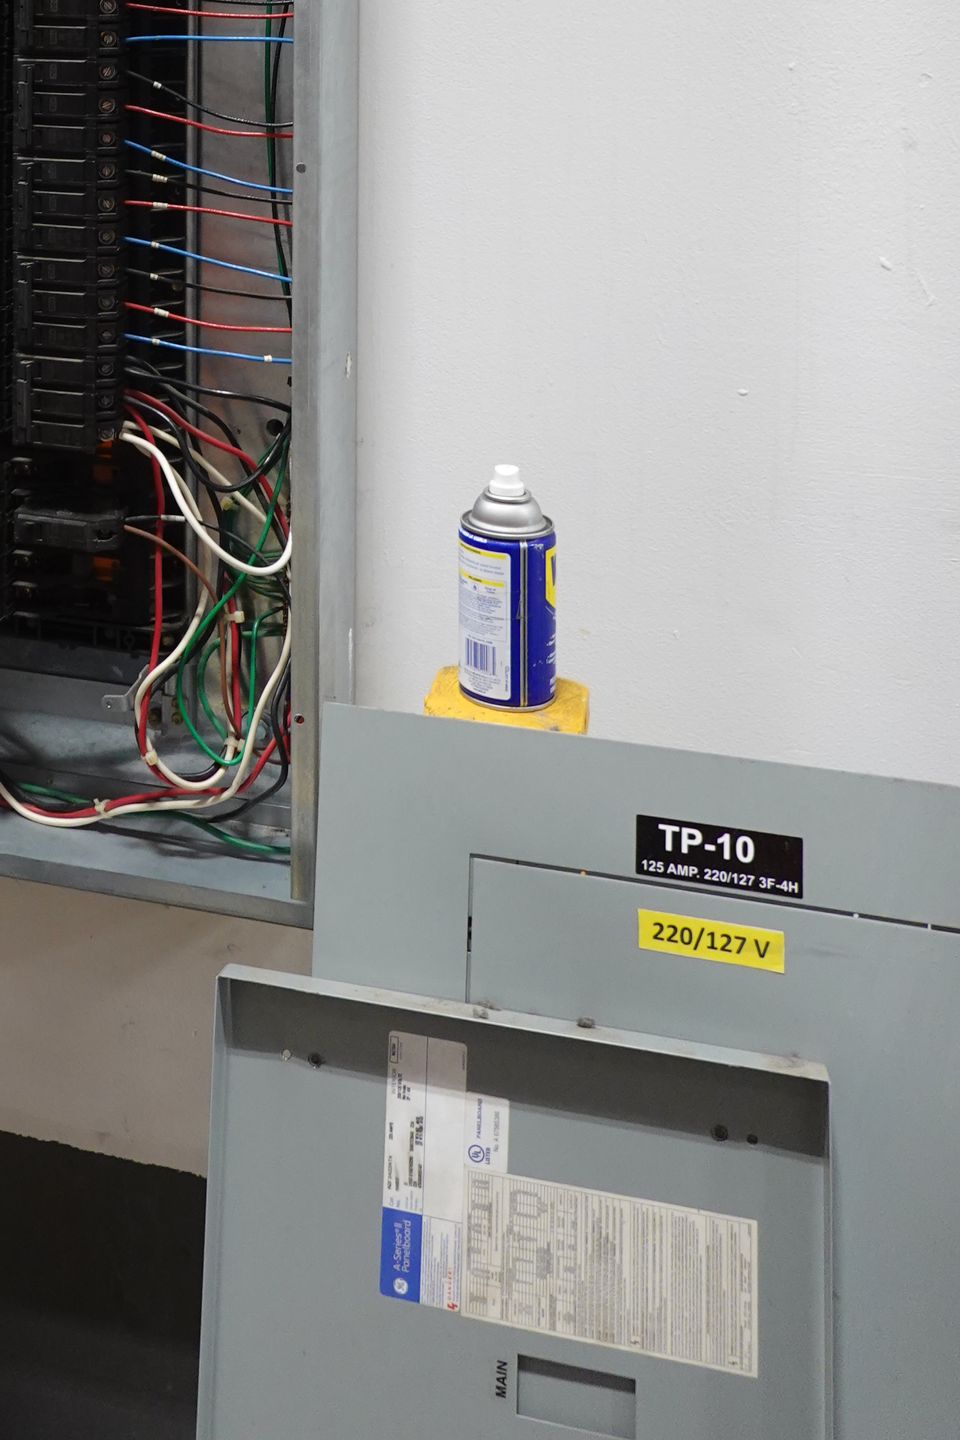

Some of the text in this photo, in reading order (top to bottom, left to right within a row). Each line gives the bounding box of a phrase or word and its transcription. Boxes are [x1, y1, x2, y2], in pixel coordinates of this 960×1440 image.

[658, 823, 755, 864] TP-10
[641, 859, 799, 894] 125 AMP. 220/127 3F-4H
[652, 922, 770, 959] 220/127 V
[401, 1220, 412, 1273] Panelboard
[495, 1360, 508, 1399] MAIN
